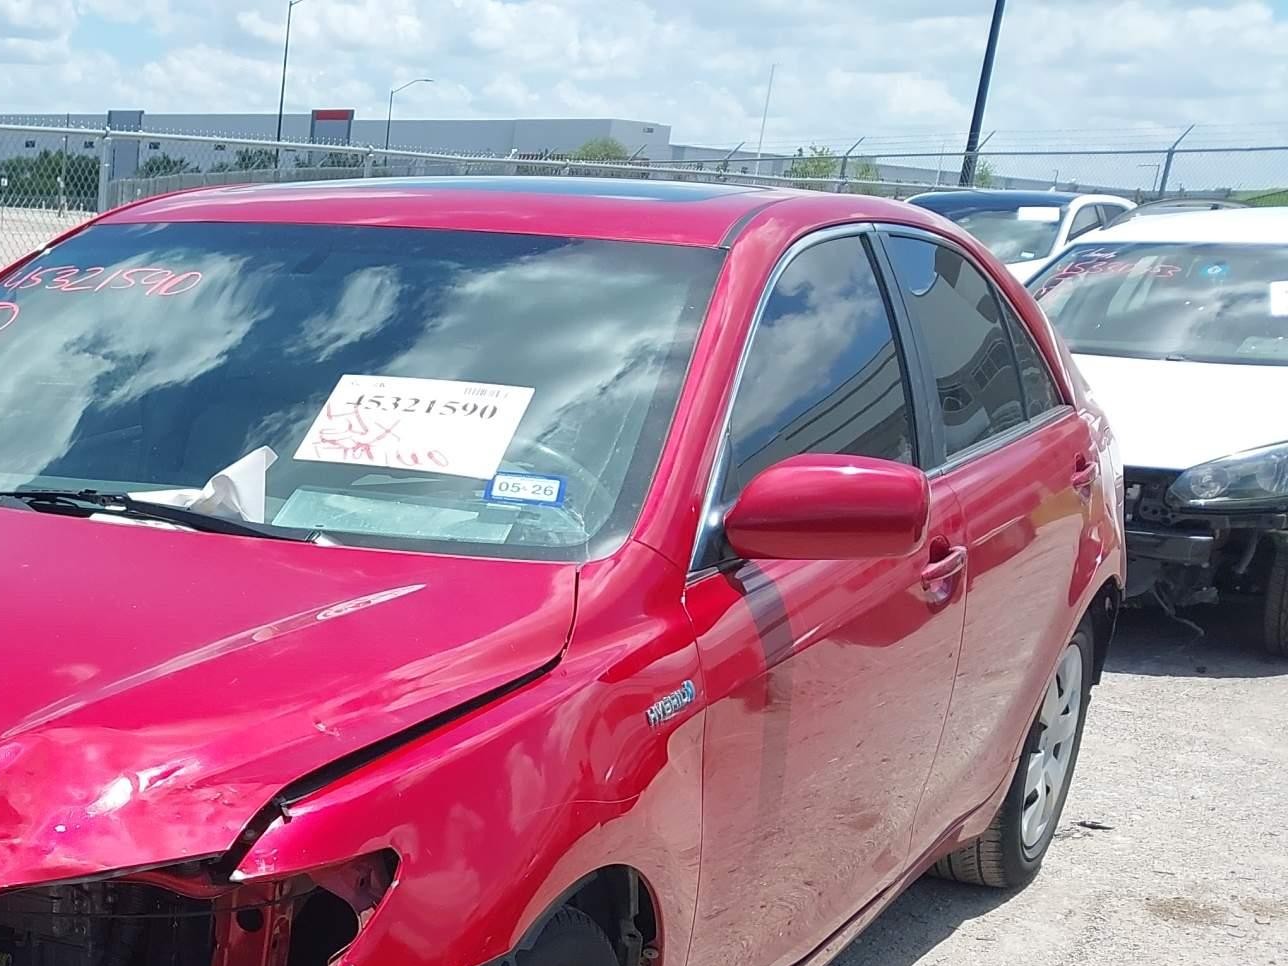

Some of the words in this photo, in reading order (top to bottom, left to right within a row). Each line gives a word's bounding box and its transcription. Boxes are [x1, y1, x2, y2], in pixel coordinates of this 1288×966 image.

[3, 264, 203, 296] 45321590
[346, 394, 499, 421] 45321590
[498, 481, 521, 493] 05
[531, 484, 554, 496] 26
[646, 679, 696, 727] HYBRID
